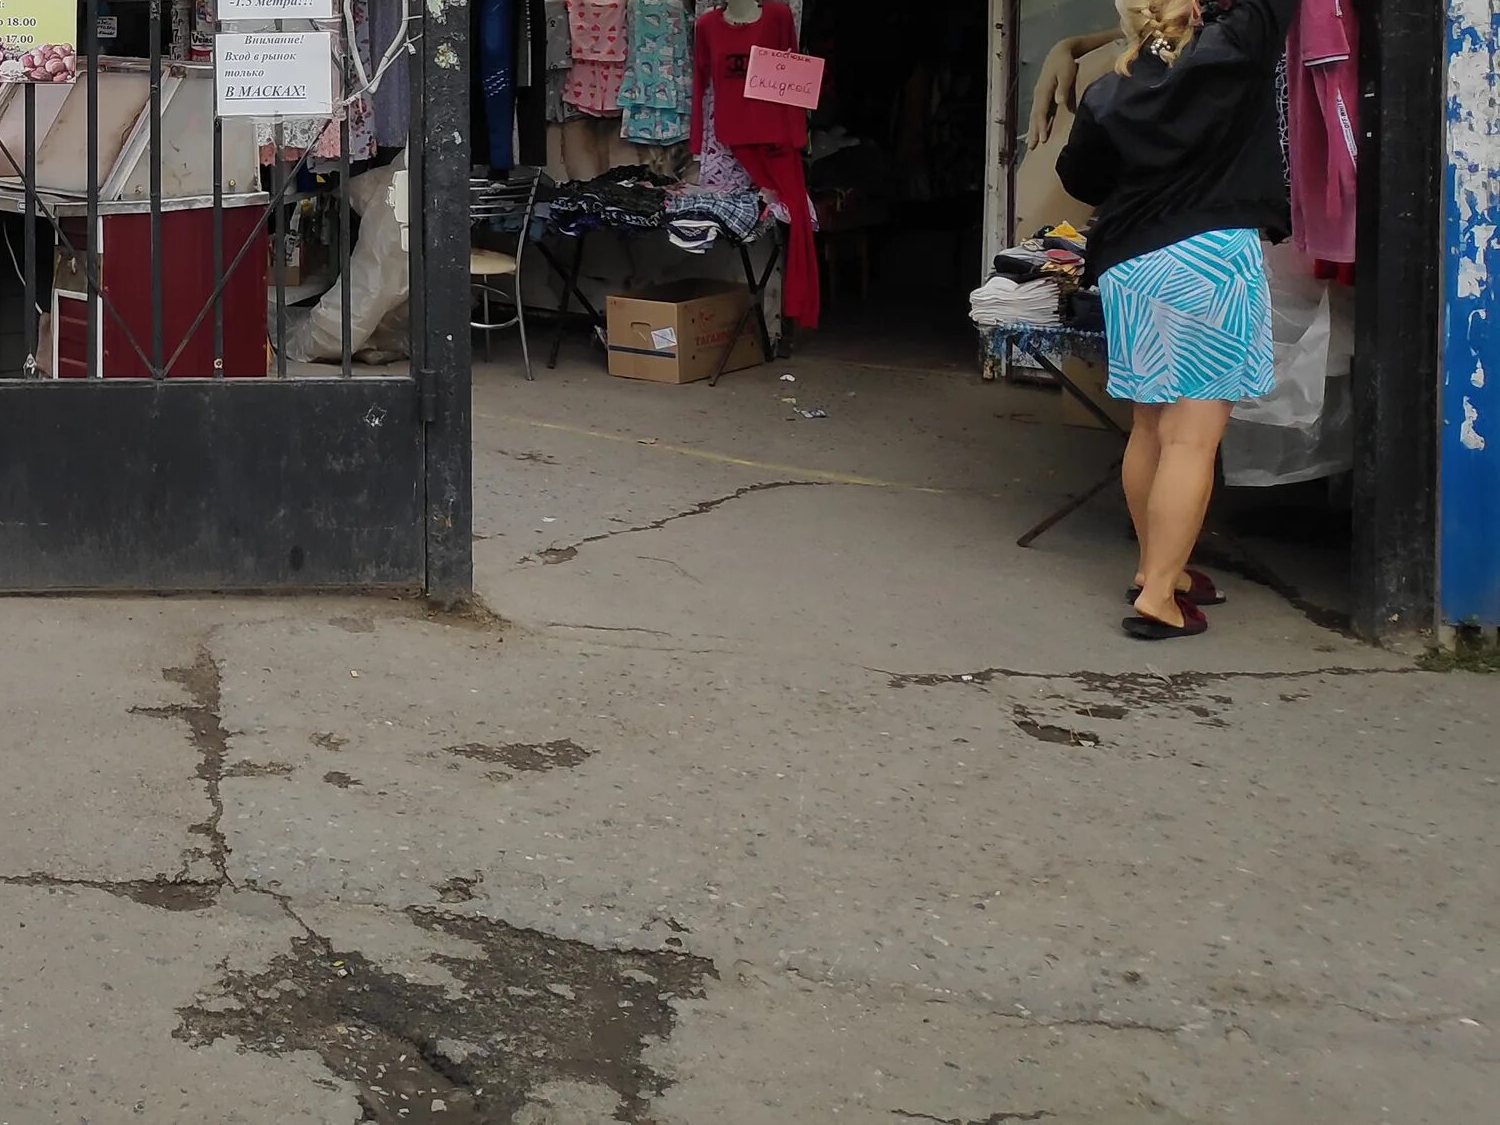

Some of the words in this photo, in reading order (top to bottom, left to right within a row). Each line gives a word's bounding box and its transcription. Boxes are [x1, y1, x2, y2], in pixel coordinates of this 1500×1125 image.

[7, 17, 37, 27] 18.00
[5, 34, 34, 44] 17.00
[244, 34, 305, 45] Внимание!
[225, 51, 251, 61] Вход
[261, 53, 297, 63] рынок
[225, 70, 265, 78] только
[749, 75, 812, 96] Скидкой
[225, 86, 235, 98] В
[238, 85, 307, 98] МАСКАХ!
